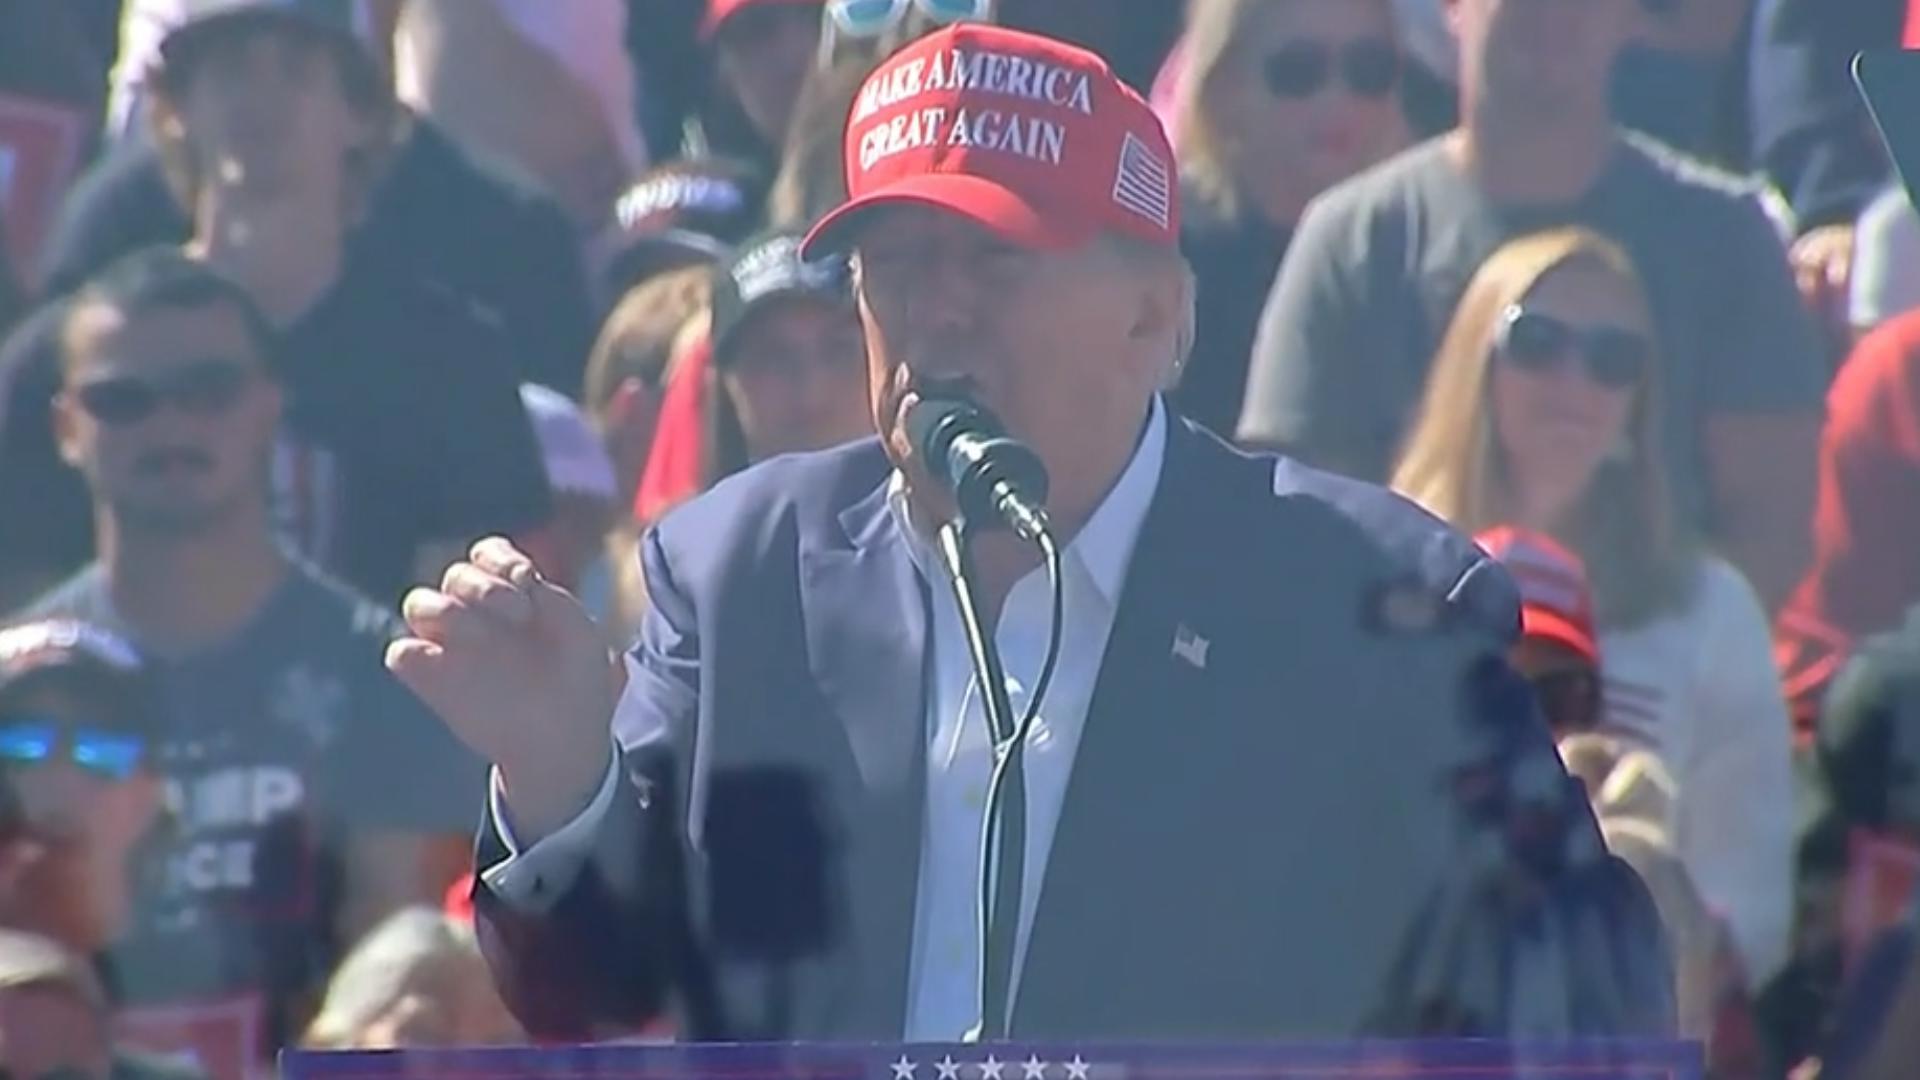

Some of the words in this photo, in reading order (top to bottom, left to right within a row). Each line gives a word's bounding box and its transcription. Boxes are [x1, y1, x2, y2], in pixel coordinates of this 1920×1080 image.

[853, 57, 926, 124] MAKE
[923, 50, 1092, 115] AMERICA
[859, 108, 945, 172] GREAT
[948, 108, 1066, 166] AGAIN
